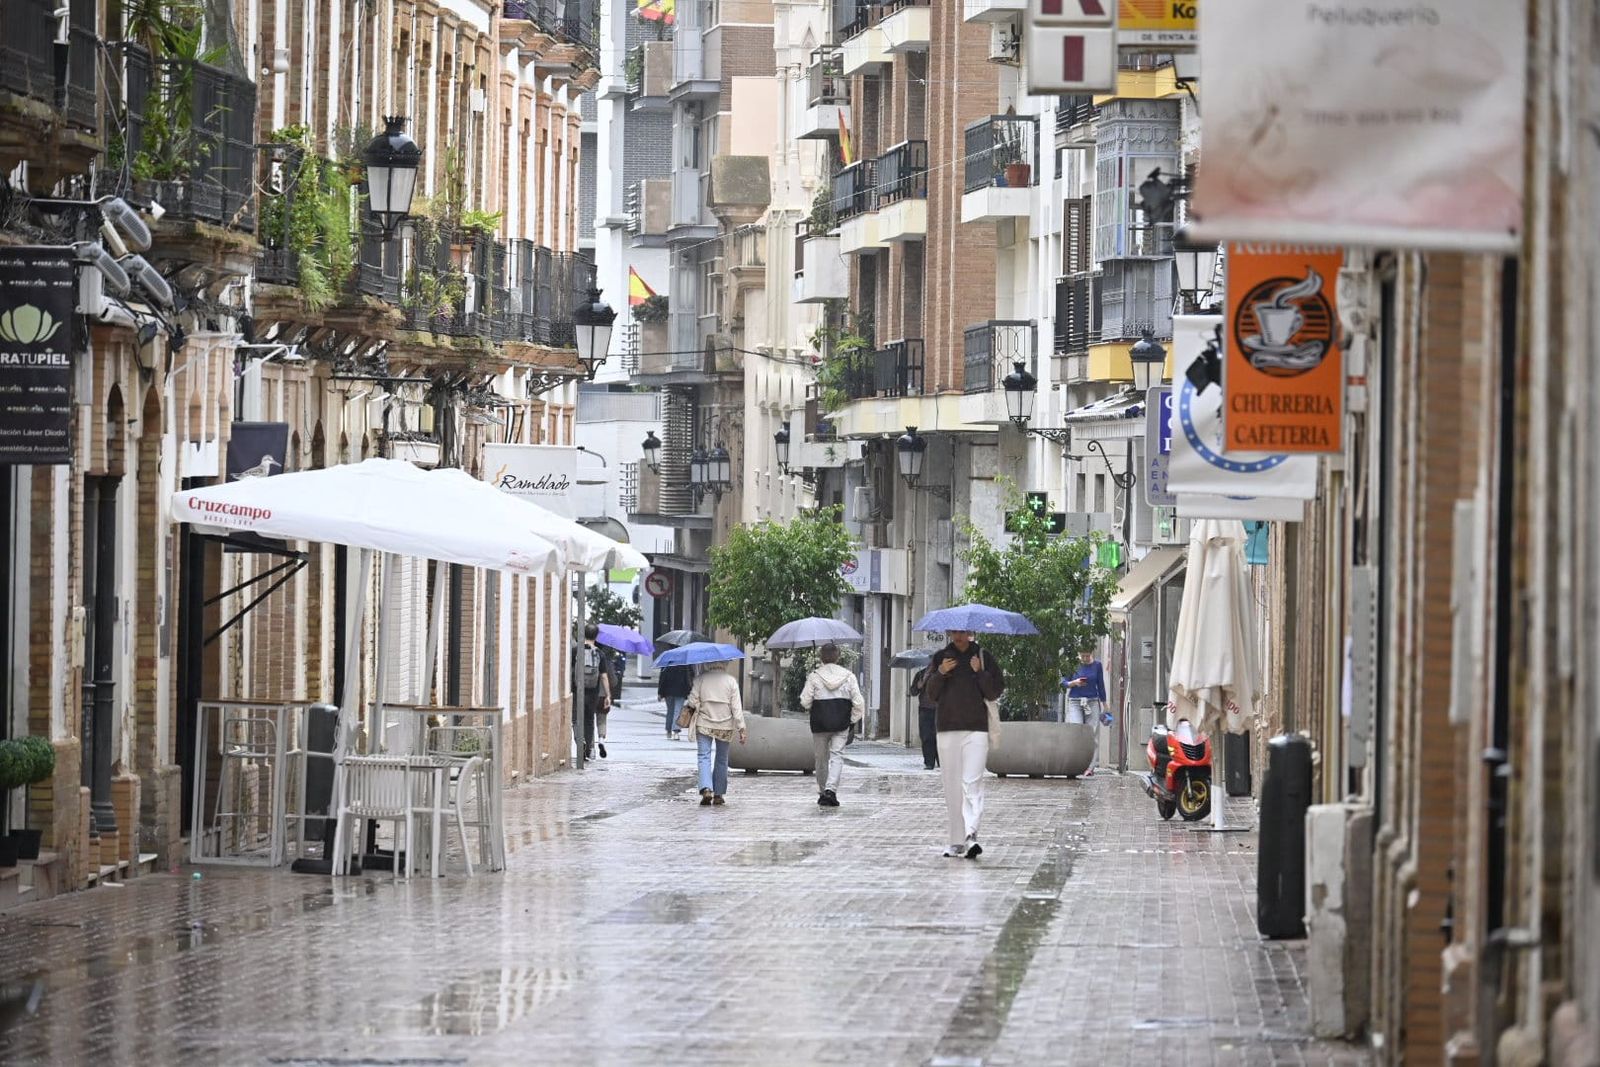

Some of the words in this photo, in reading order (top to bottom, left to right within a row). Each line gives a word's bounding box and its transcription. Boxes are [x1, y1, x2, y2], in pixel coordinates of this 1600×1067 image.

[1158, 33, 1184, 41] VENTA
[1232, 394, 1334, 415] CHURRERIA
[1234, 424, 1330, 446] CAFETERIA
[500, 474, 569, 490] Ramblado
[188, 496, 272, 521] Cruzcampo
